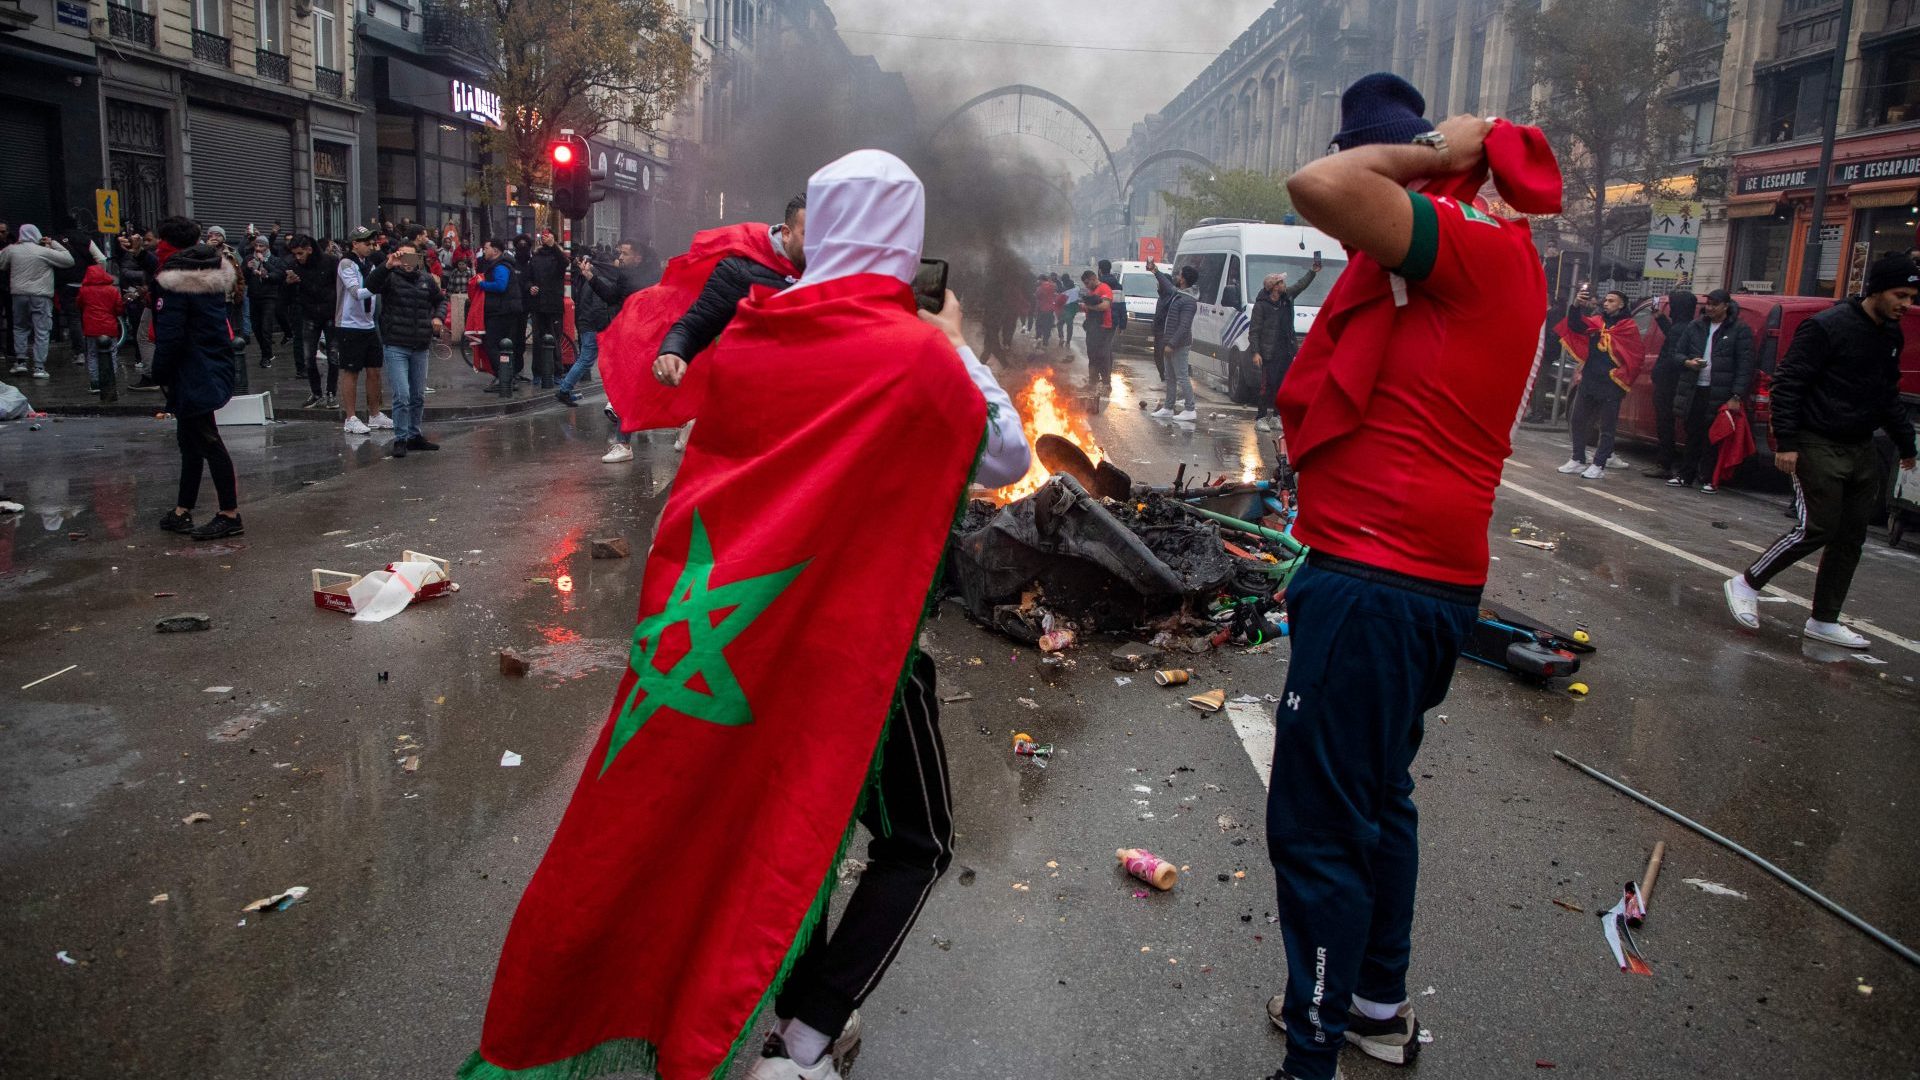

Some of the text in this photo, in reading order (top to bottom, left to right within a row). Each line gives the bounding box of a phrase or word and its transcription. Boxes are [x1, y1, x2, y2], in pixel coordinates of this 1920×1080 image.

[1843, 157, 1920, 180] ICE L'ESCAPADE
[1744, 177, 1758, 191] ICE
[1312, 946, 1327, 1006] ARMOUR
